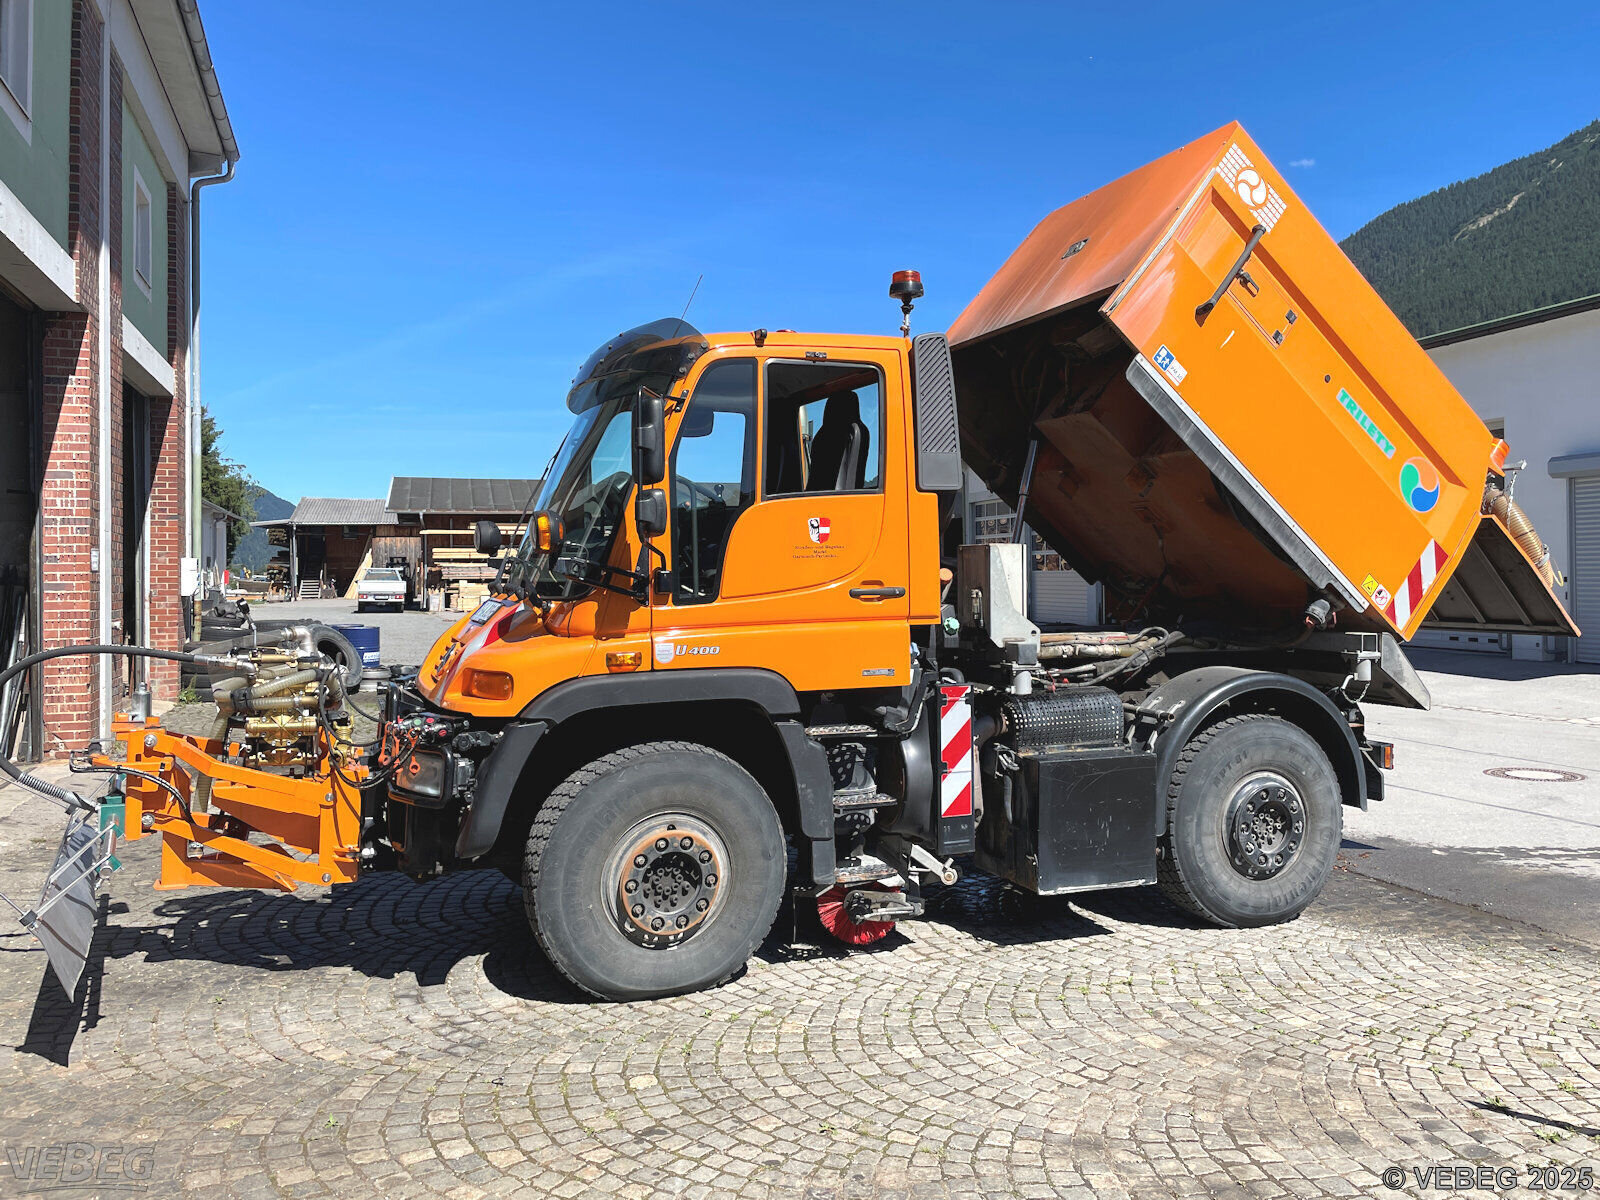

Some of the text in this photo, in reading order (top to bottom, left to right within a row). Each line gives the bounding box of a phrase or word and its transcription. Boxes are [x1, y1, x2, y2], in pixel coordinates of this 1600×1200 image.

[1340, 389, 1396, 454] TRILETY
[675, 644, 688, 656] U
[688, 645, 720, 656] 400
